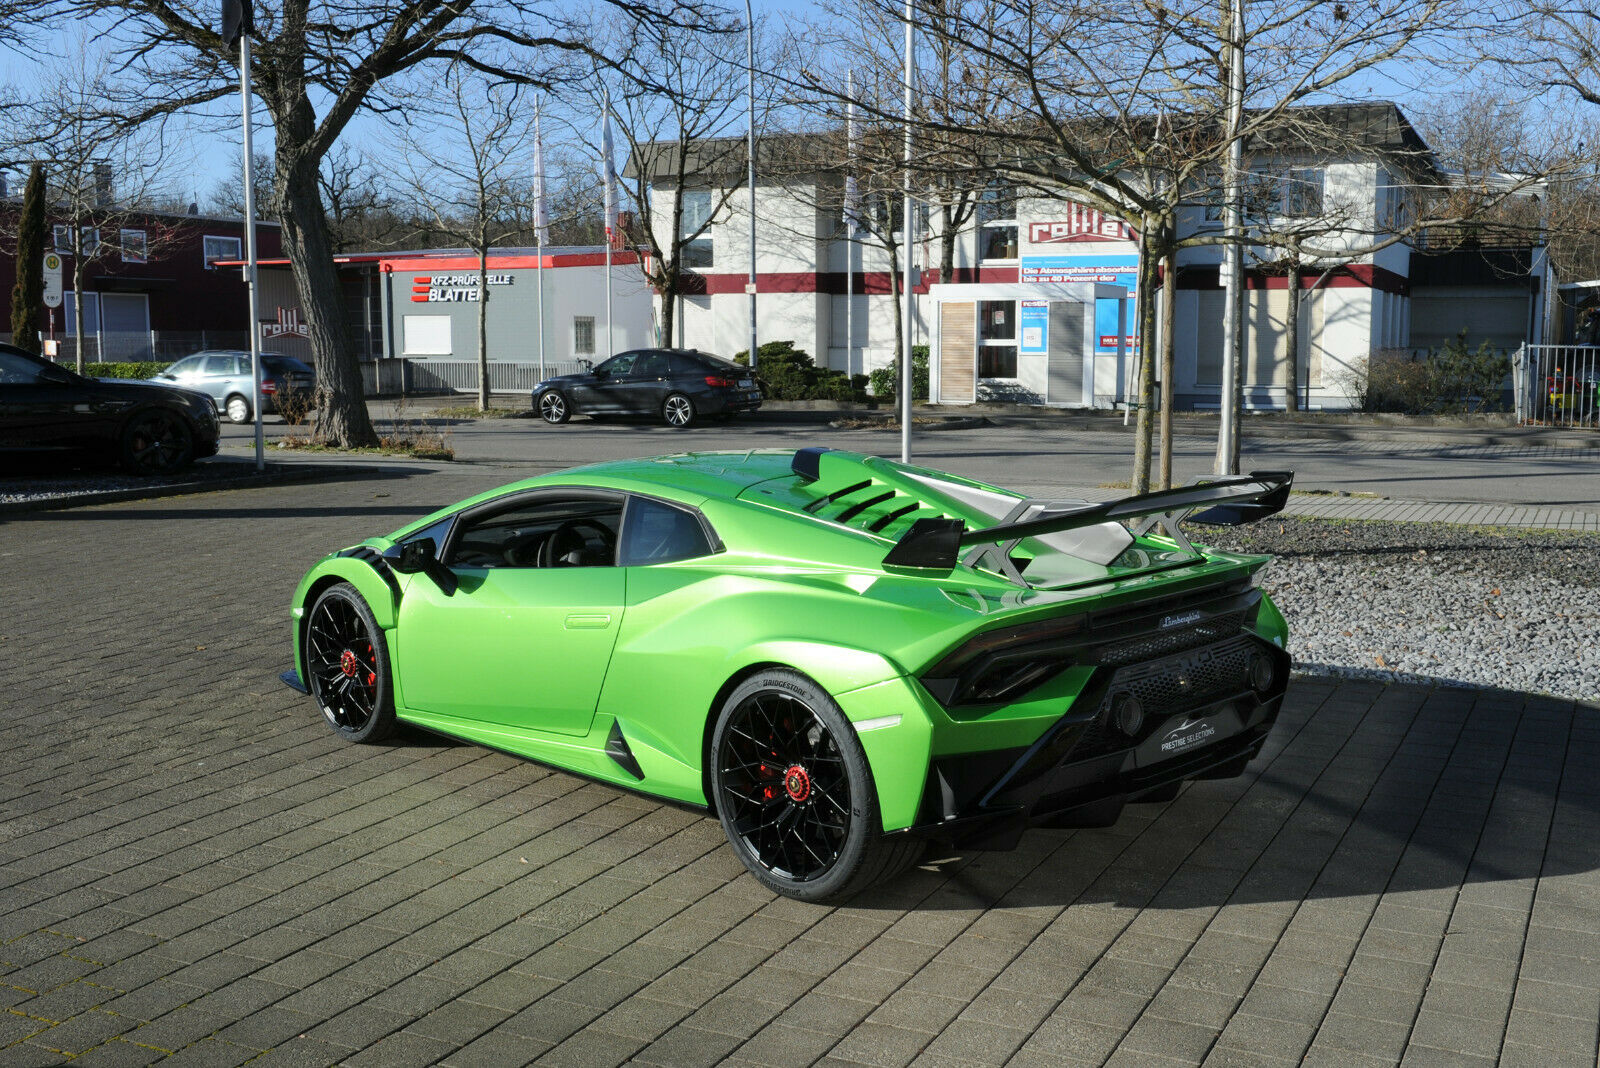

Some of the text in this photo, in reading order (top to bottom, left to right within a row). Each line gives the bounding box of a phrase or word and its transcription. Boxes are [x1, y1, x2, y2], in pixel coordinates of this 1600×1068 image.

[1023, 265, 1137, 275] Die Atmosphäre absorbie
[1099, 274, 1115, 282] der
[430, 274, 510, 285] KFZ-PRÜFSELLE
[262, 308, 308, 337] rottle
[1162, 611, 1201, 628] Lamborghini
[763, 679, 807, 697] BRIDGESTONE
[1161, 737, 1187, 751] PRESTIGE
[1186, 727, 1215, 744] SELECTIONS
